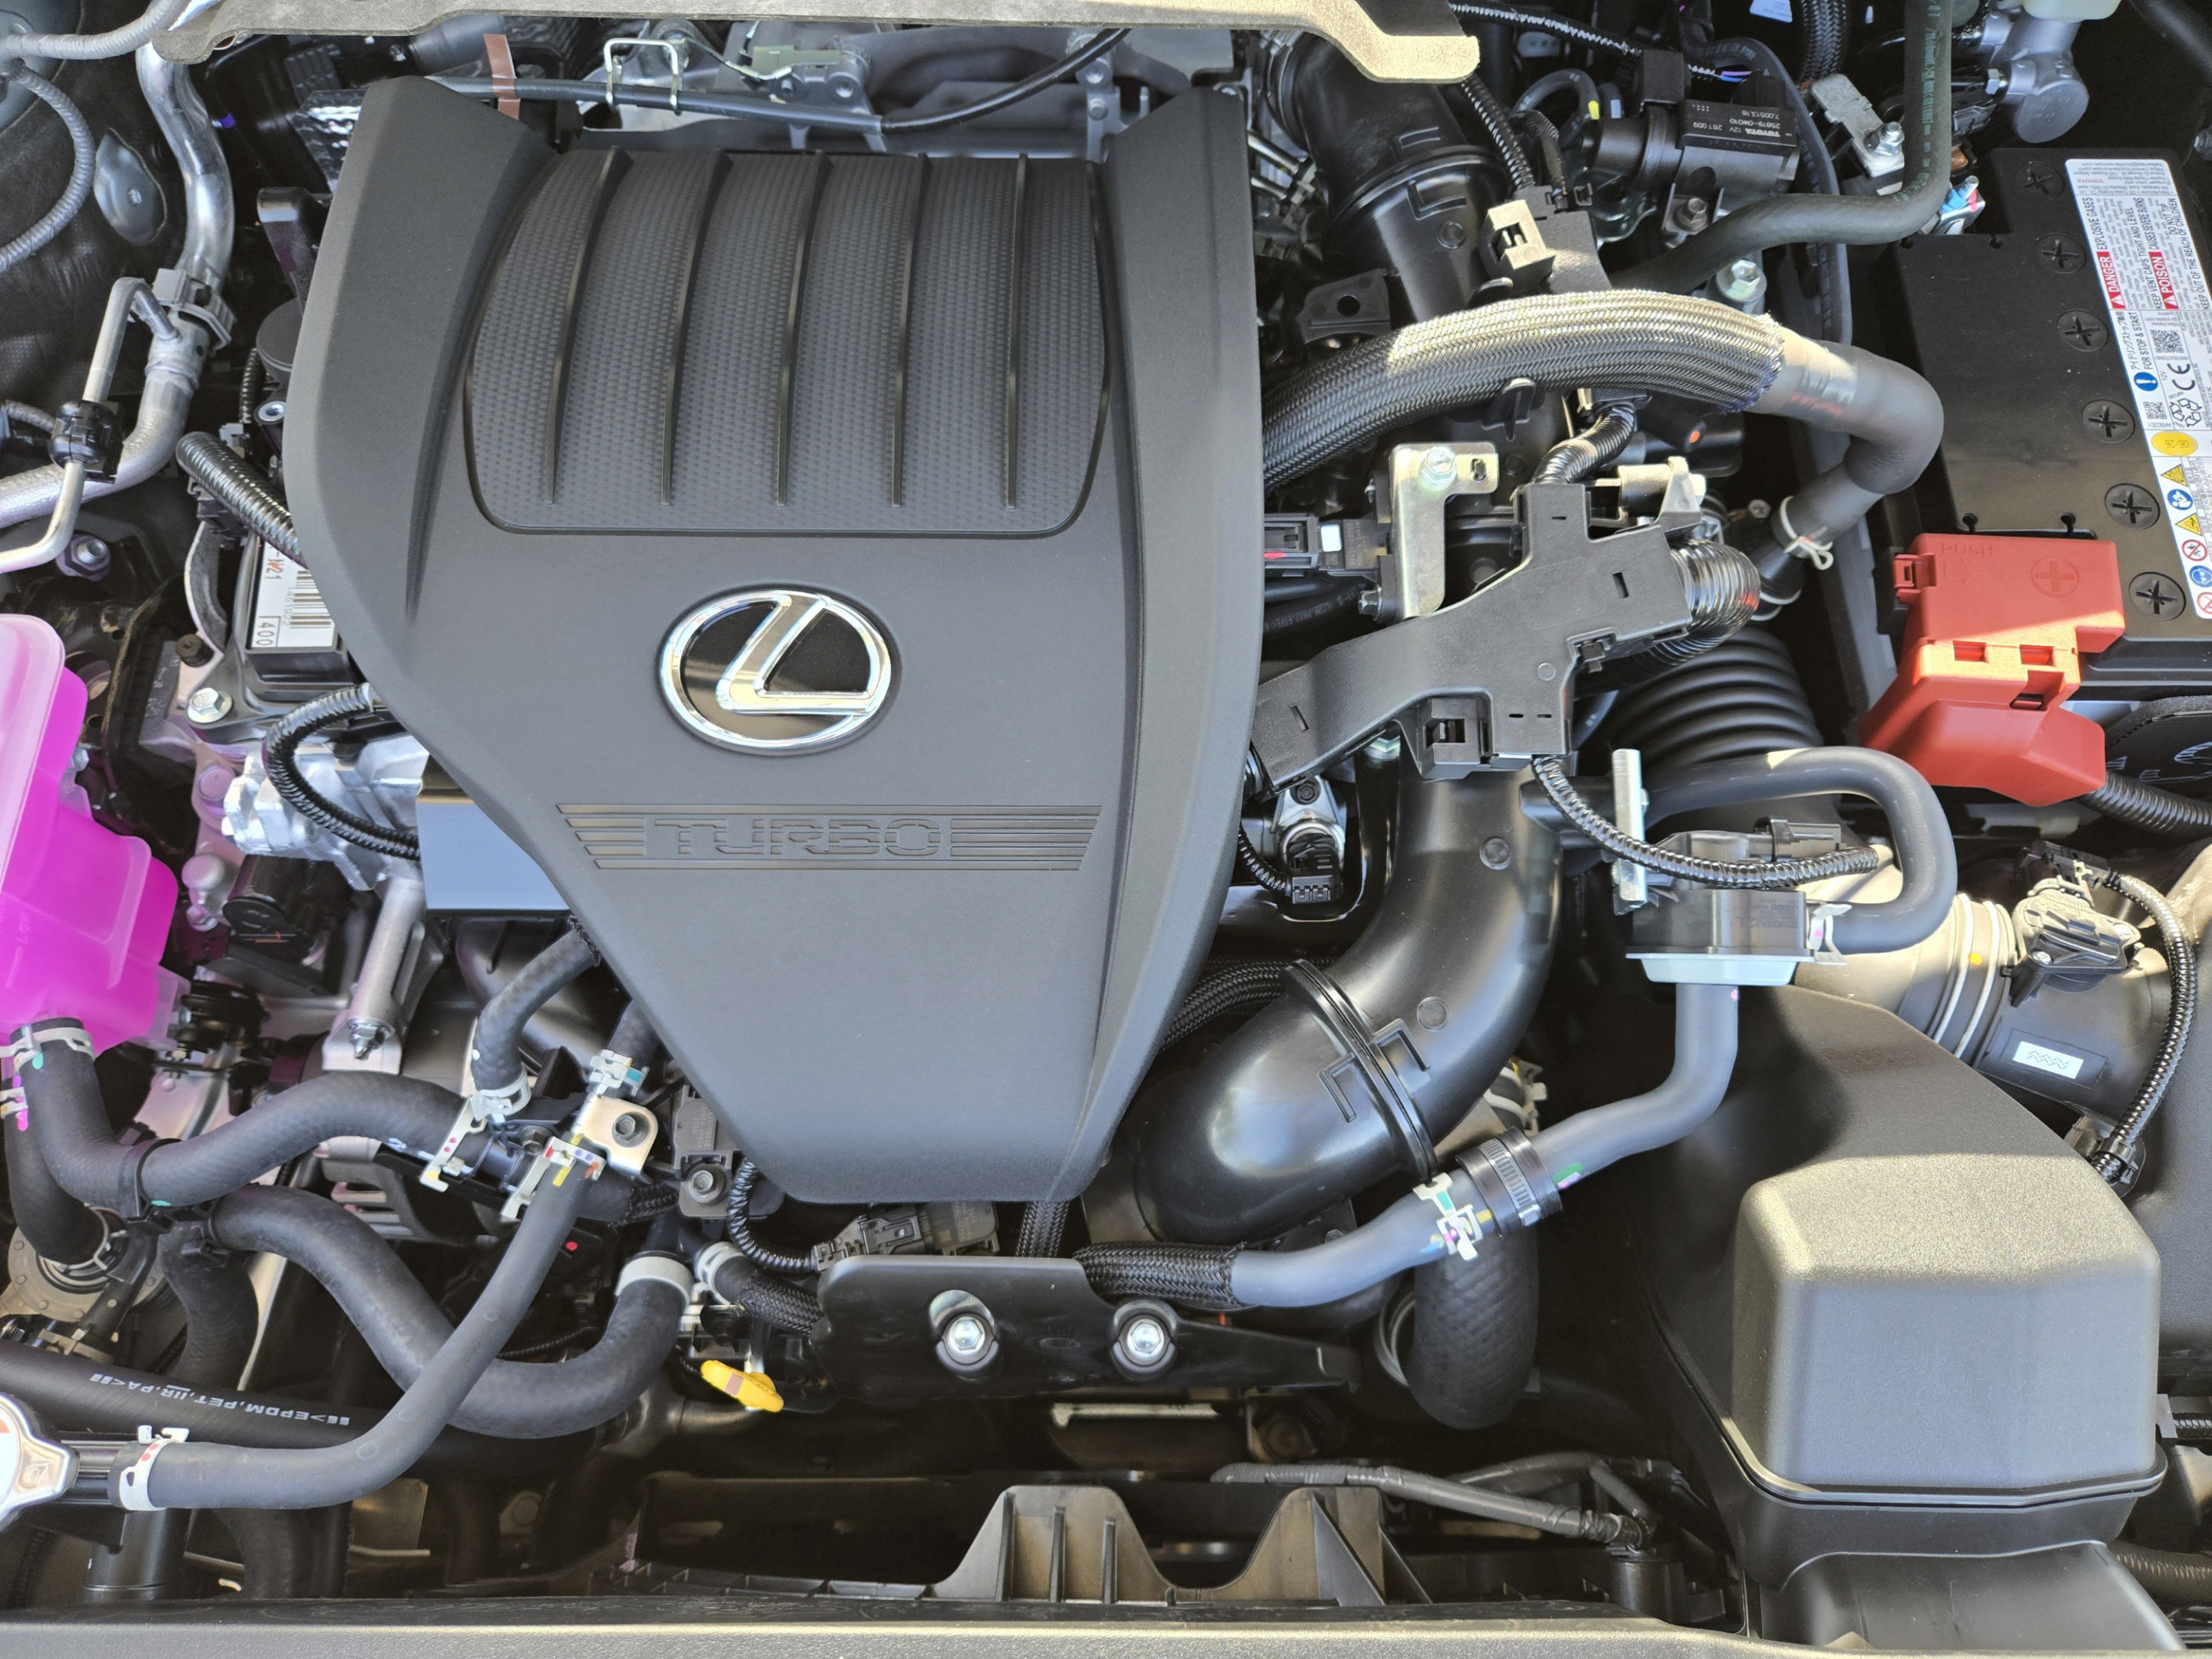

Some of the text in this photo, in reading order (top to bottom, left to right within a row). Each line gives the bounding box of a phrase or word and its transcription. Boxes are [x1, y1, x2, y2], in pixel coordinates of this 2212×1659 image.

[1745, 127, 1780, 137] TOYOTA
[2128, 311, 2141, 330] START
[2135, 338, 2148, 354] STOP
[2141, 356, 2152, 369] FOR
[2165, 439, 2189, 448] 06/26
[1941, 542, 1995, 557] PUSH
[256, 622, 276, 645] 400
[655, 816, 944, 856] TURBO
